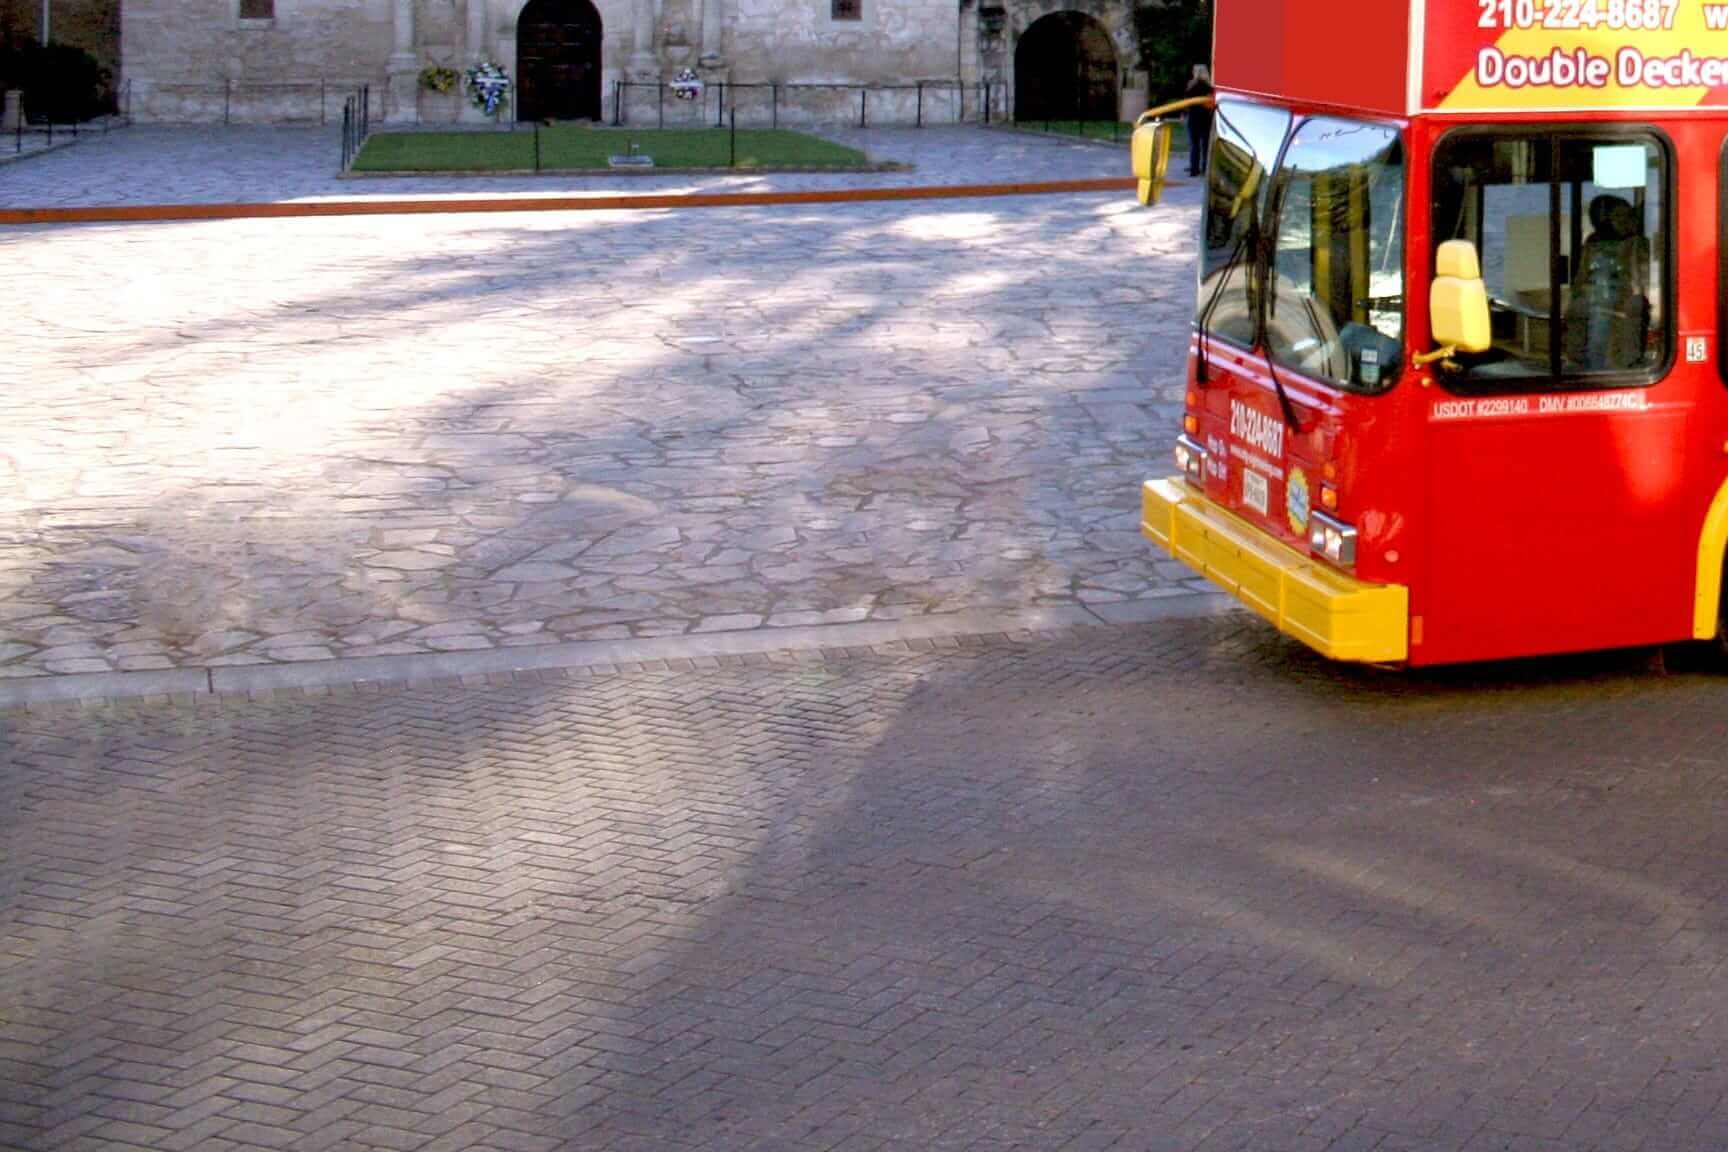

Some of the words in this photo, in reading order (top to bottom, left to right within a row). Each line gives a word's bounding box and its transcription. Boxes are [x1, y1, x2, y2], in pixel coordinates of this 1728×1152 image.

[1476, 47, 1610, 86] Double
[1687, 342, 1703, 360] 45
[1433, 400, 1475, 417] USDOT
[1539, 395, 1566, 412] DMV
